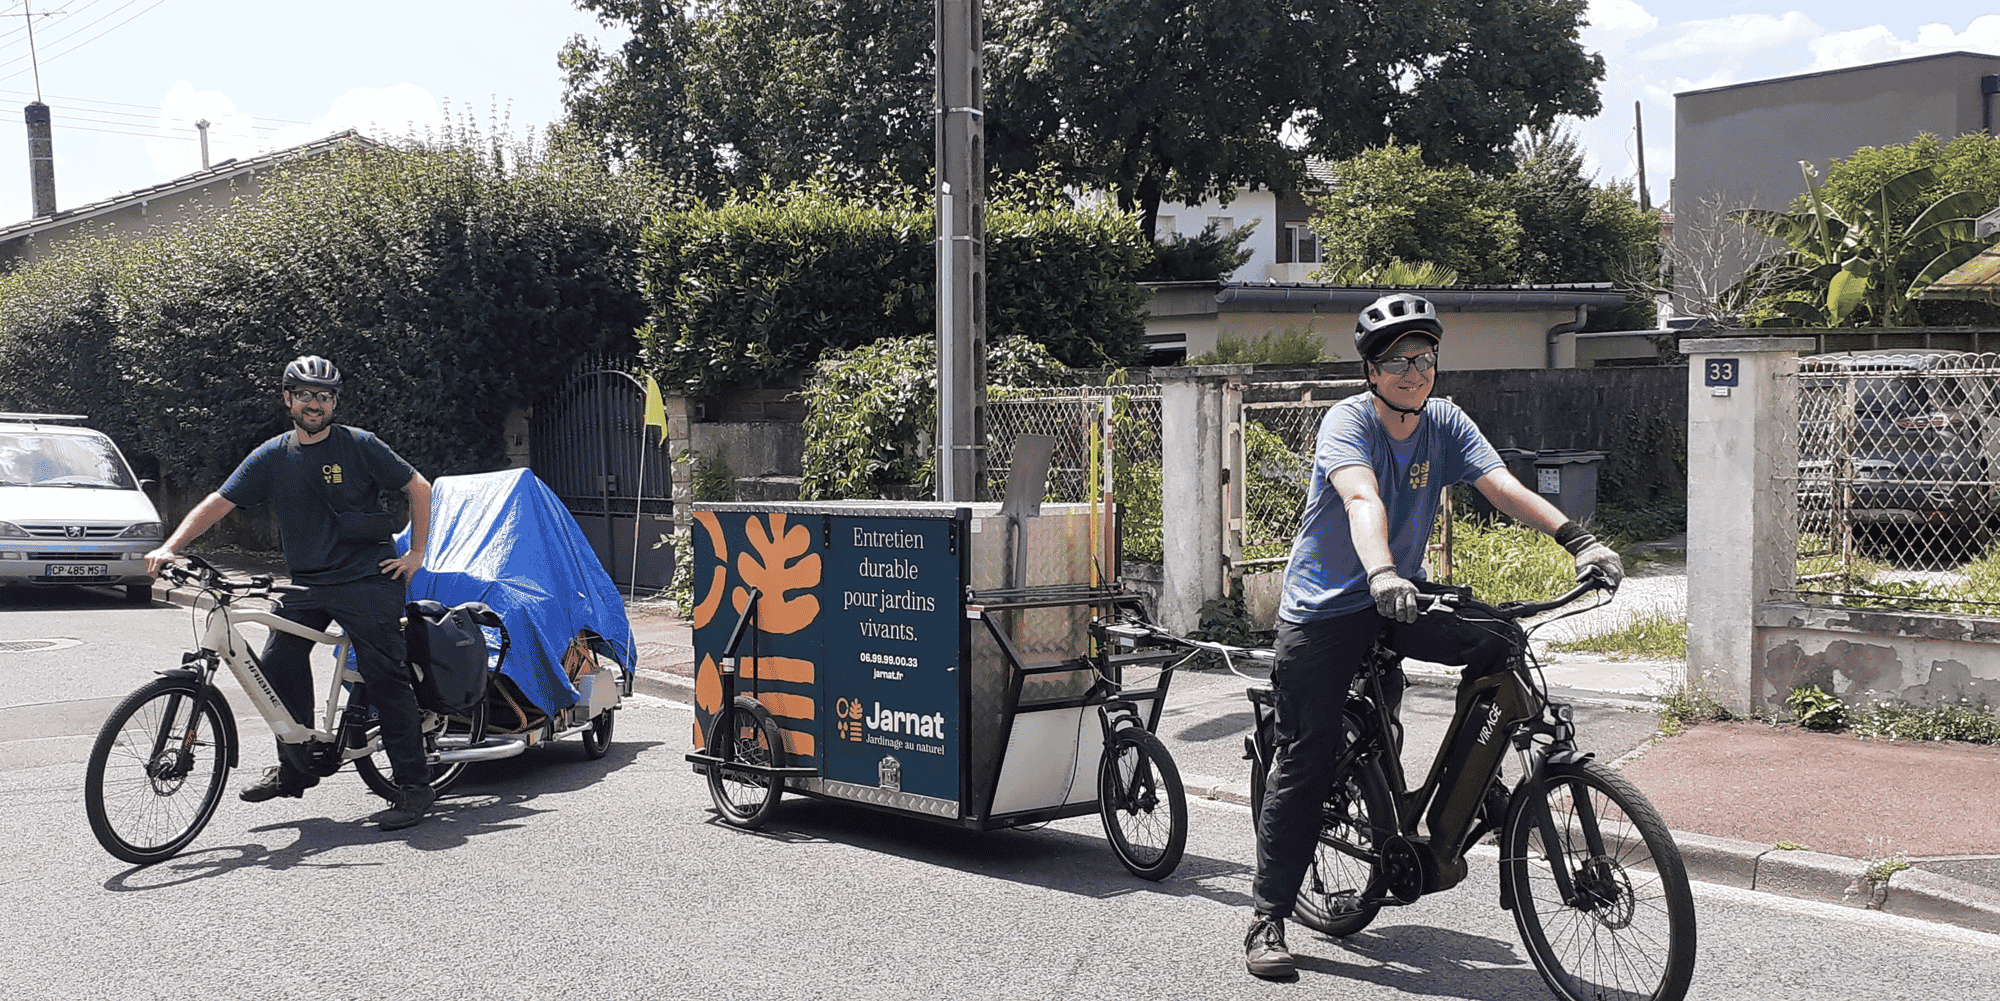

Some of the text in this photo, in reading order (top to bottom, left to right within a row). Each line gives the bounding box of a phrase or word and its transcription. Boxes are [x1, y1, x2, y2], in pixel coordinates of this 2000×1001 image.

[1709, 362, 1733, 380] 33
[853, 526, 925, 549] Entretien
[859, 557, 919, 580] durable
[843, 589, 936, 613] pour jardins
[859, 618, 918, 642] vivants.
[860, 652, 919, 668] 06.99.99.00.33
[244, 659, 281, 709] HAIBIKE
[873, 667, 904, 681] jarnat.fr
[865, 701, 945, 740] Jarnat
[1476, 702, 1502, 746] VIRAGE
[866, 733, 945, 756] Jardinage au naturel
